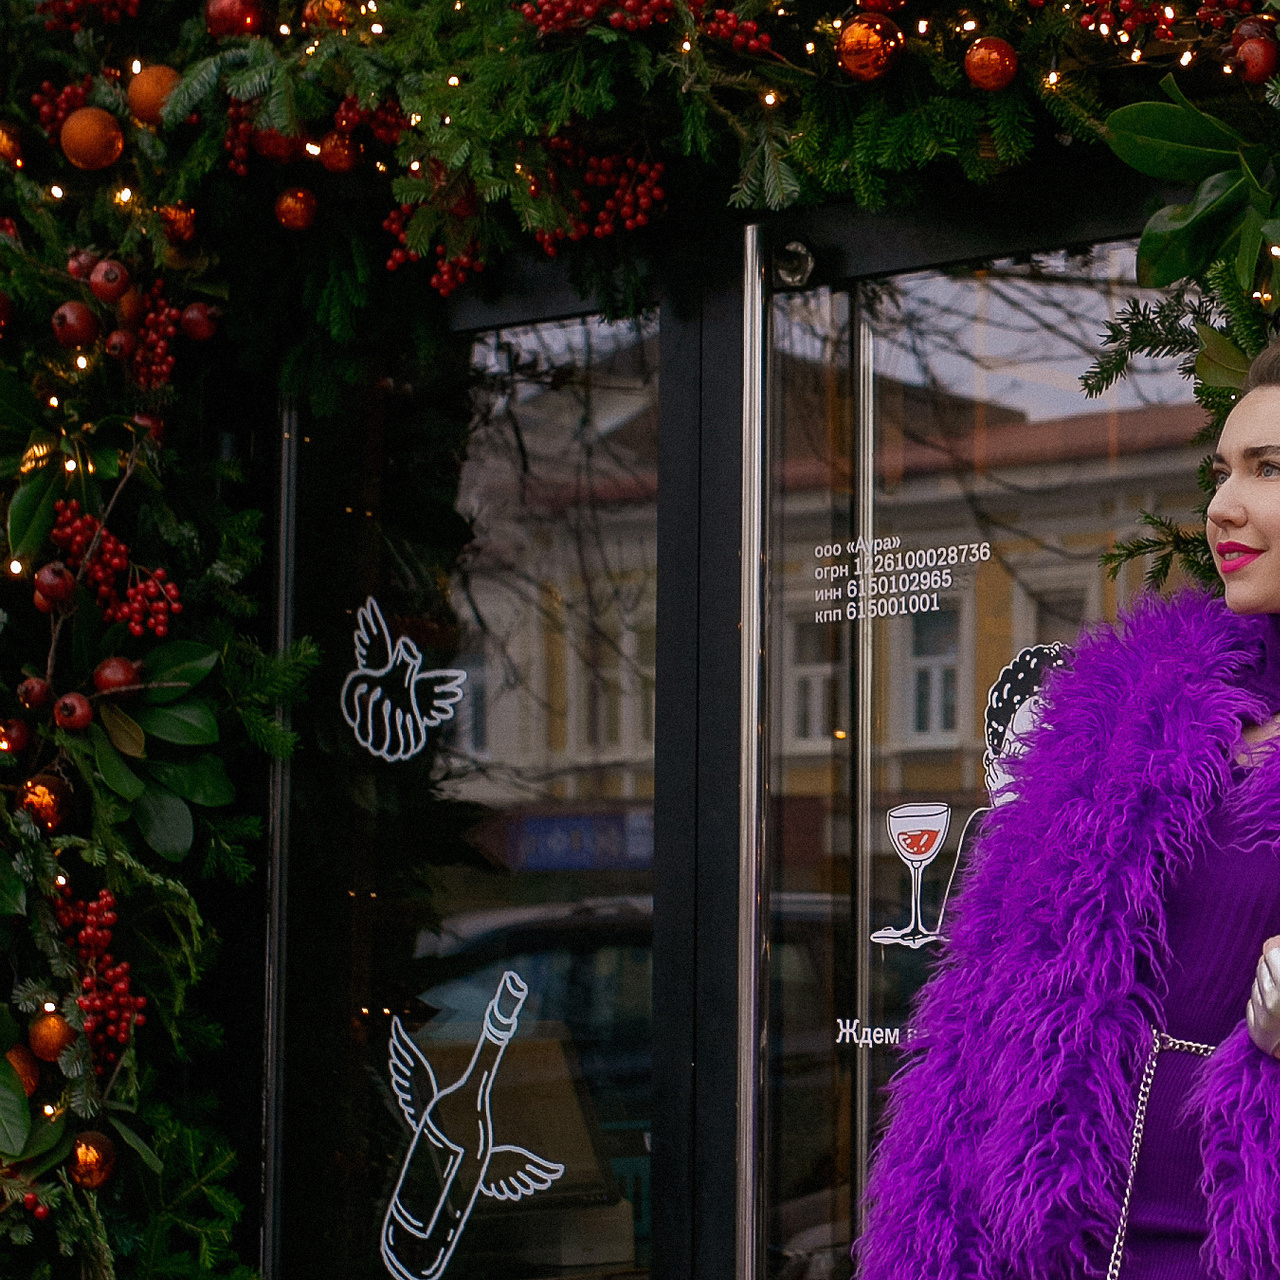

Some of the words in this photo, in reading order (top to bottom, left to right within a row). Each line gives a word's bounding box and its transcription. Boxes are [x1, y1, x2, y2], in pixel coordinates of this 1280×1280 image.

[846, 536, 901, 555] «Аура»
[815, 564, 849, 581] огрн
[854, 542, 991, 575] 1226100028736
[847, 569, 952, 598] 6150102965
[846, 593, 940, 619] 615001001
[836, 1019, 900, 1048] Ждем
